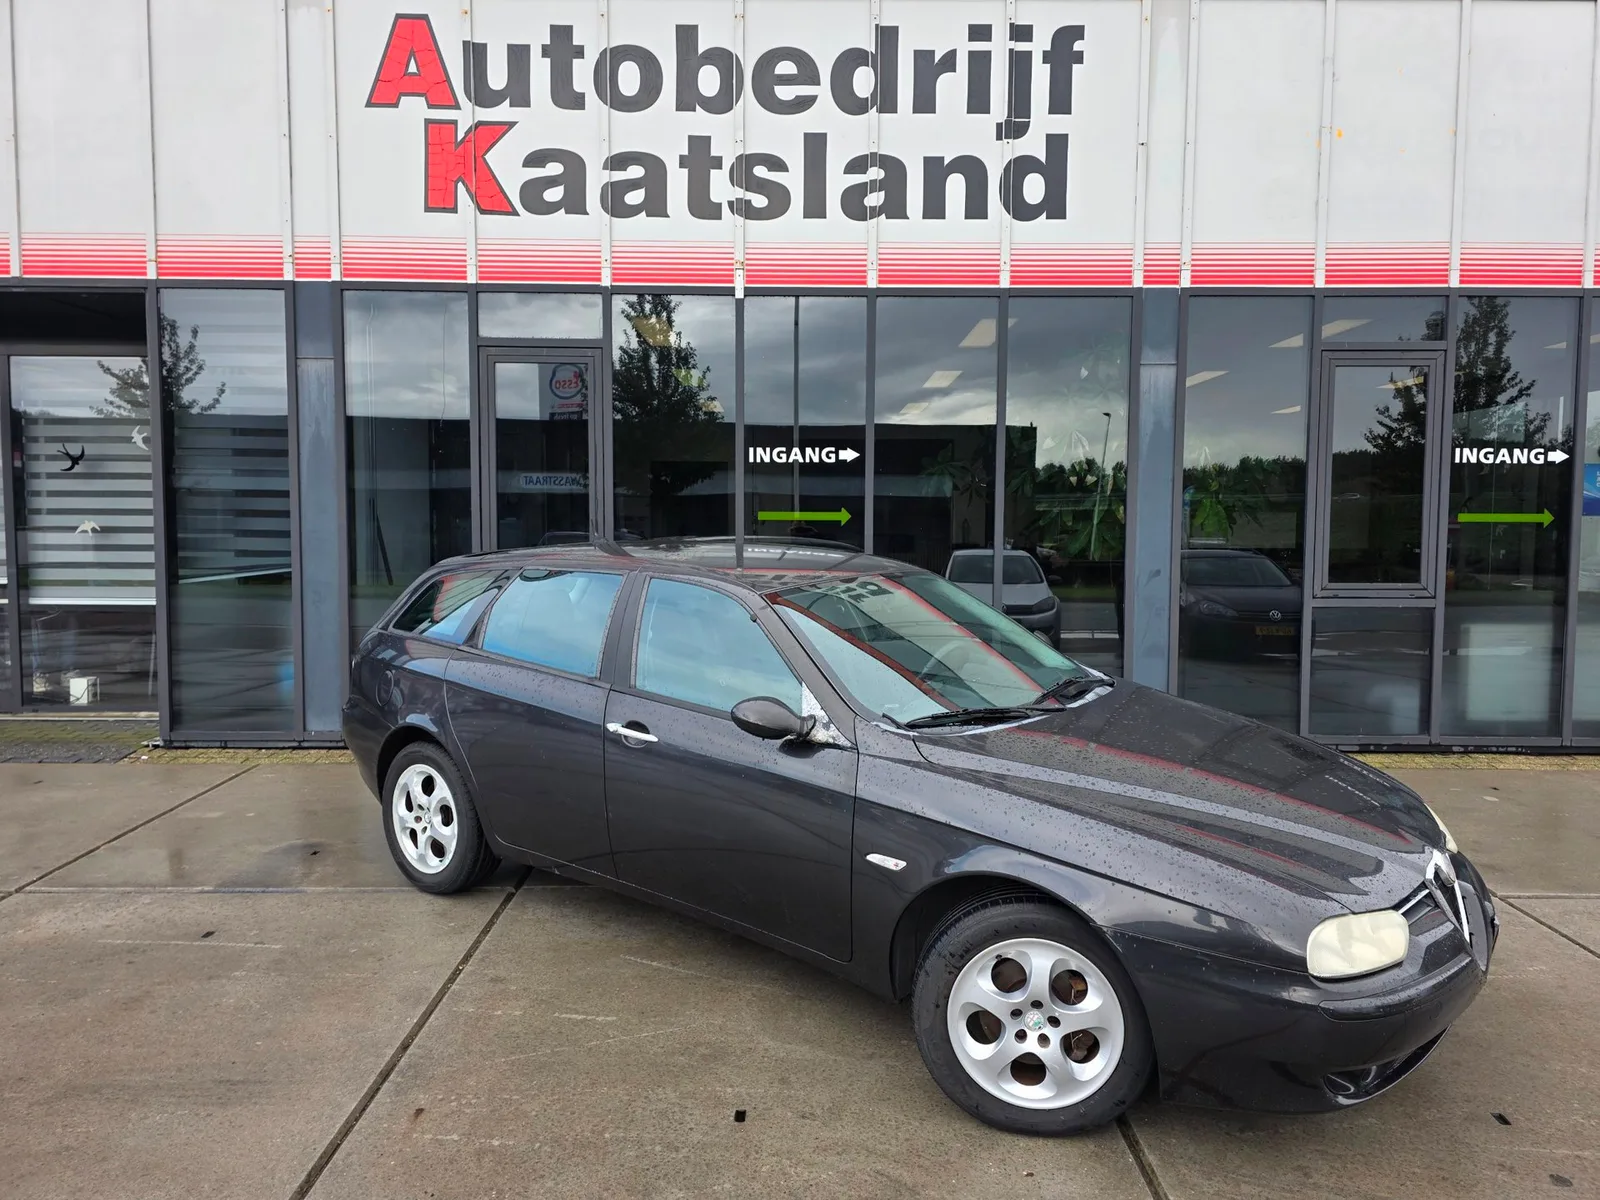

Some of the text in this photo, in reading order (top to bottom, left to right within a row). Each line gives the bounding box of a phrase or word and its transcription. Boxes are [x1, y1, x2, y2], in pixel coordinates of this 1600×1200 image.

[365, 13, 1085, 141] Autobedrijf
[424, 118, 1069, 222] Kaatsland
[748, 447, 836, 463] INGANG
[1454, 447, 1545, 464] INGANG
